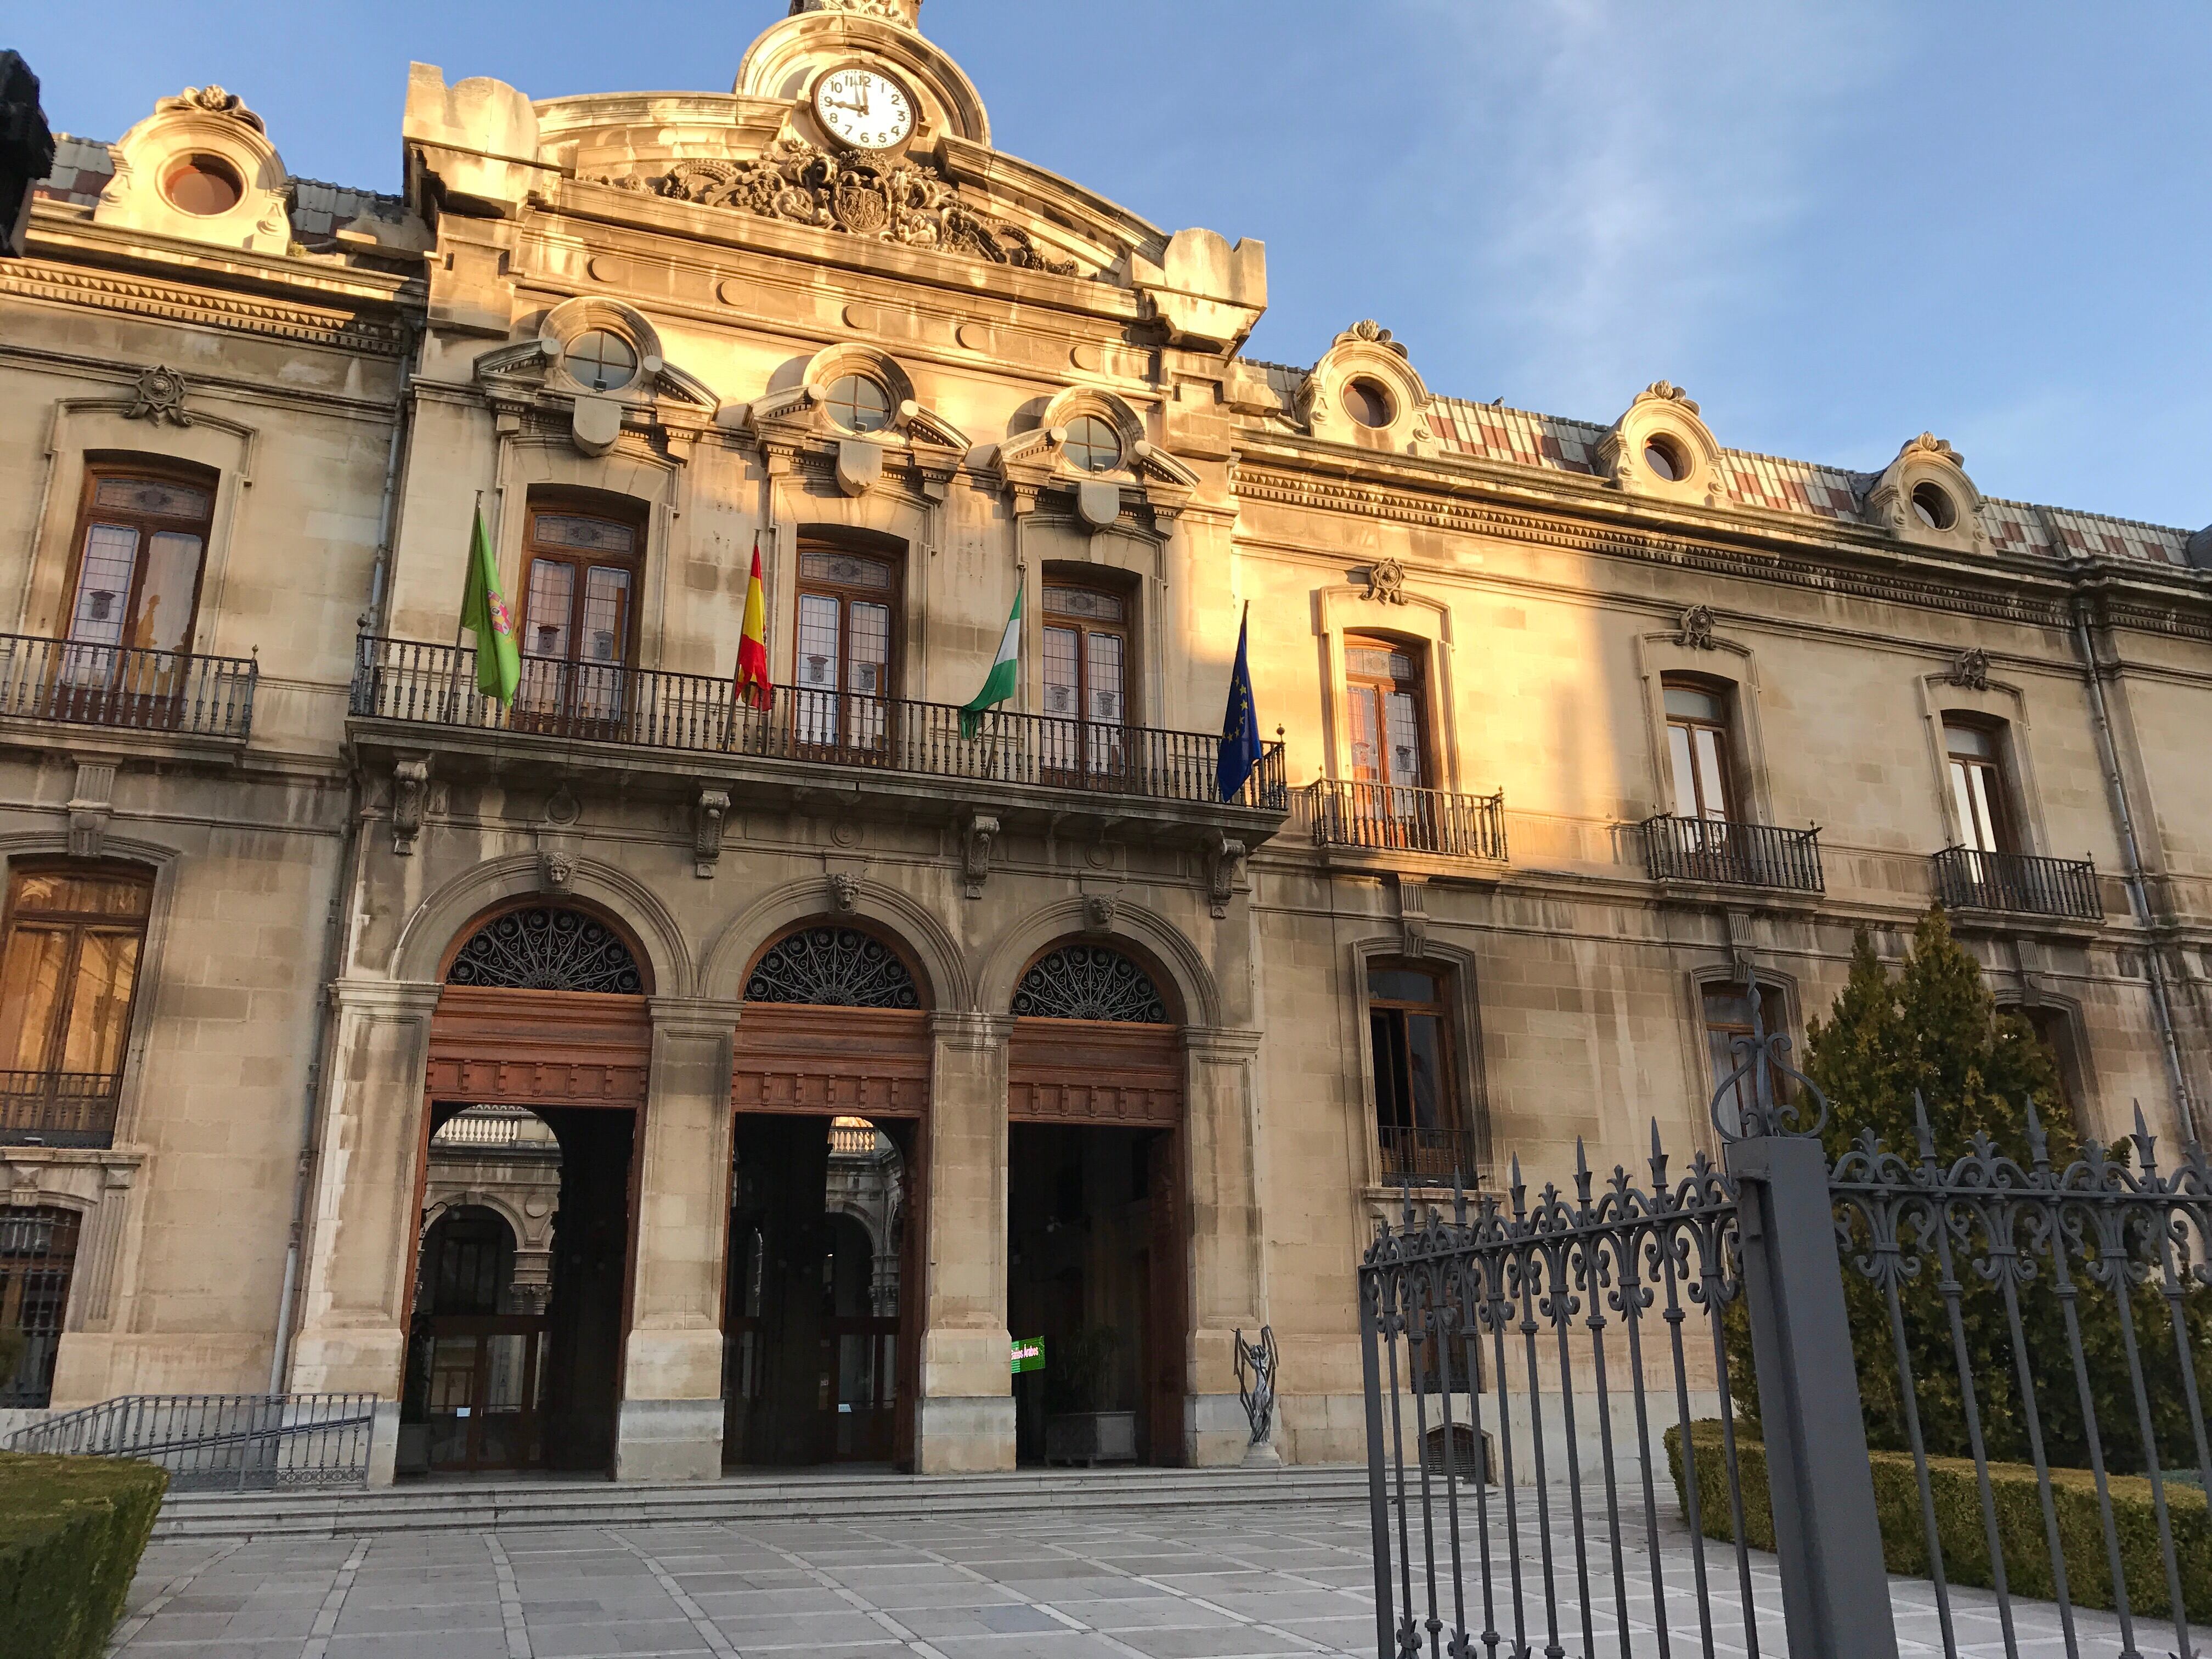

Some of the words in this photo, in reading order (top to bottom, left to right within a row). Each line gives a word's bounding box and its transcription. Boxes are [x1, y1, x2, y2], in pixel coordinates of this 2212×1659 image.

[859, 75, 871, 87] 12
[831, 81, 843, 93] 10
[881, 82, 884, 93] 1
[824, 96, 833, 107] 9
[891, 94, 900, 105] 2
[830, 112, 838, 123] 8
[897, 110, 905, 121] 3
[845, 125, 853, 135] 7
[891, 126, 900, 136] 4
[860, 132, 869, 143] 6
[878, 132, 887, 143] 5
